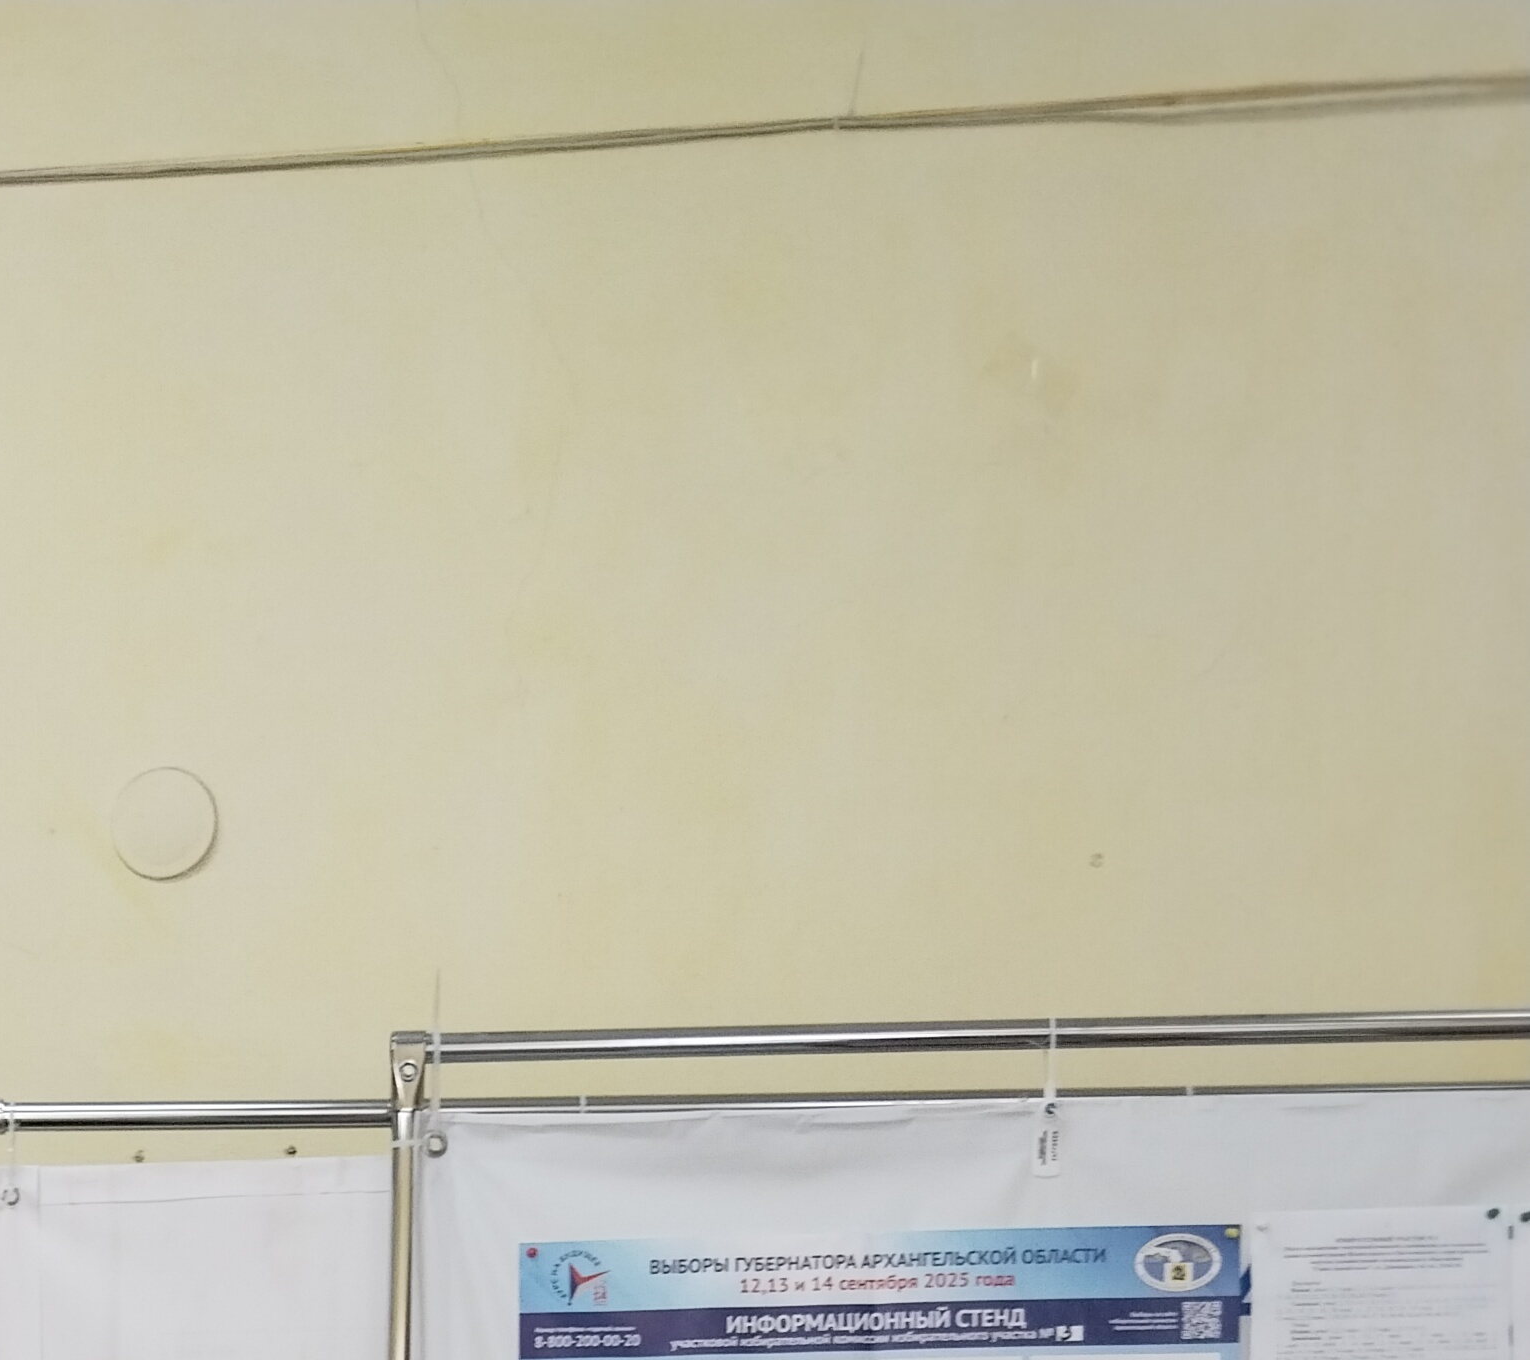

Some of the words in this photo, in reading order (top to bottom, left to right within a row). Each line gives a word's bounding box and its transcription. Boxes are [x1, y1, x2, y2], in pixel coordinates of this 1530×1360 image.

[650, 1258, 729, 1275] ВЫБОРЫ
[734, 1254, 855, 1272] ГУБЕРНАТОРА
[861, 1247, 1016, 1269] АРХАНГЕЛЬСКОЙ
[1022, 1248, 1108, 1265] ОБЛАСТИ
[740, 1278, 789, 1294] 12,13
[794, 1280, 806, 1291] и
[812, 1276, 833, 1291] 14
[839, 1275, 919, 1293] сентября
[924, 1272, 969, 1289] 2025
[975, 1274, 1015, 1288] года
[726, 1307, 951, 1334] ИНФОРМАЦИОННЫЙ
[955, 1308, 1027, 1329] СТЕНД
